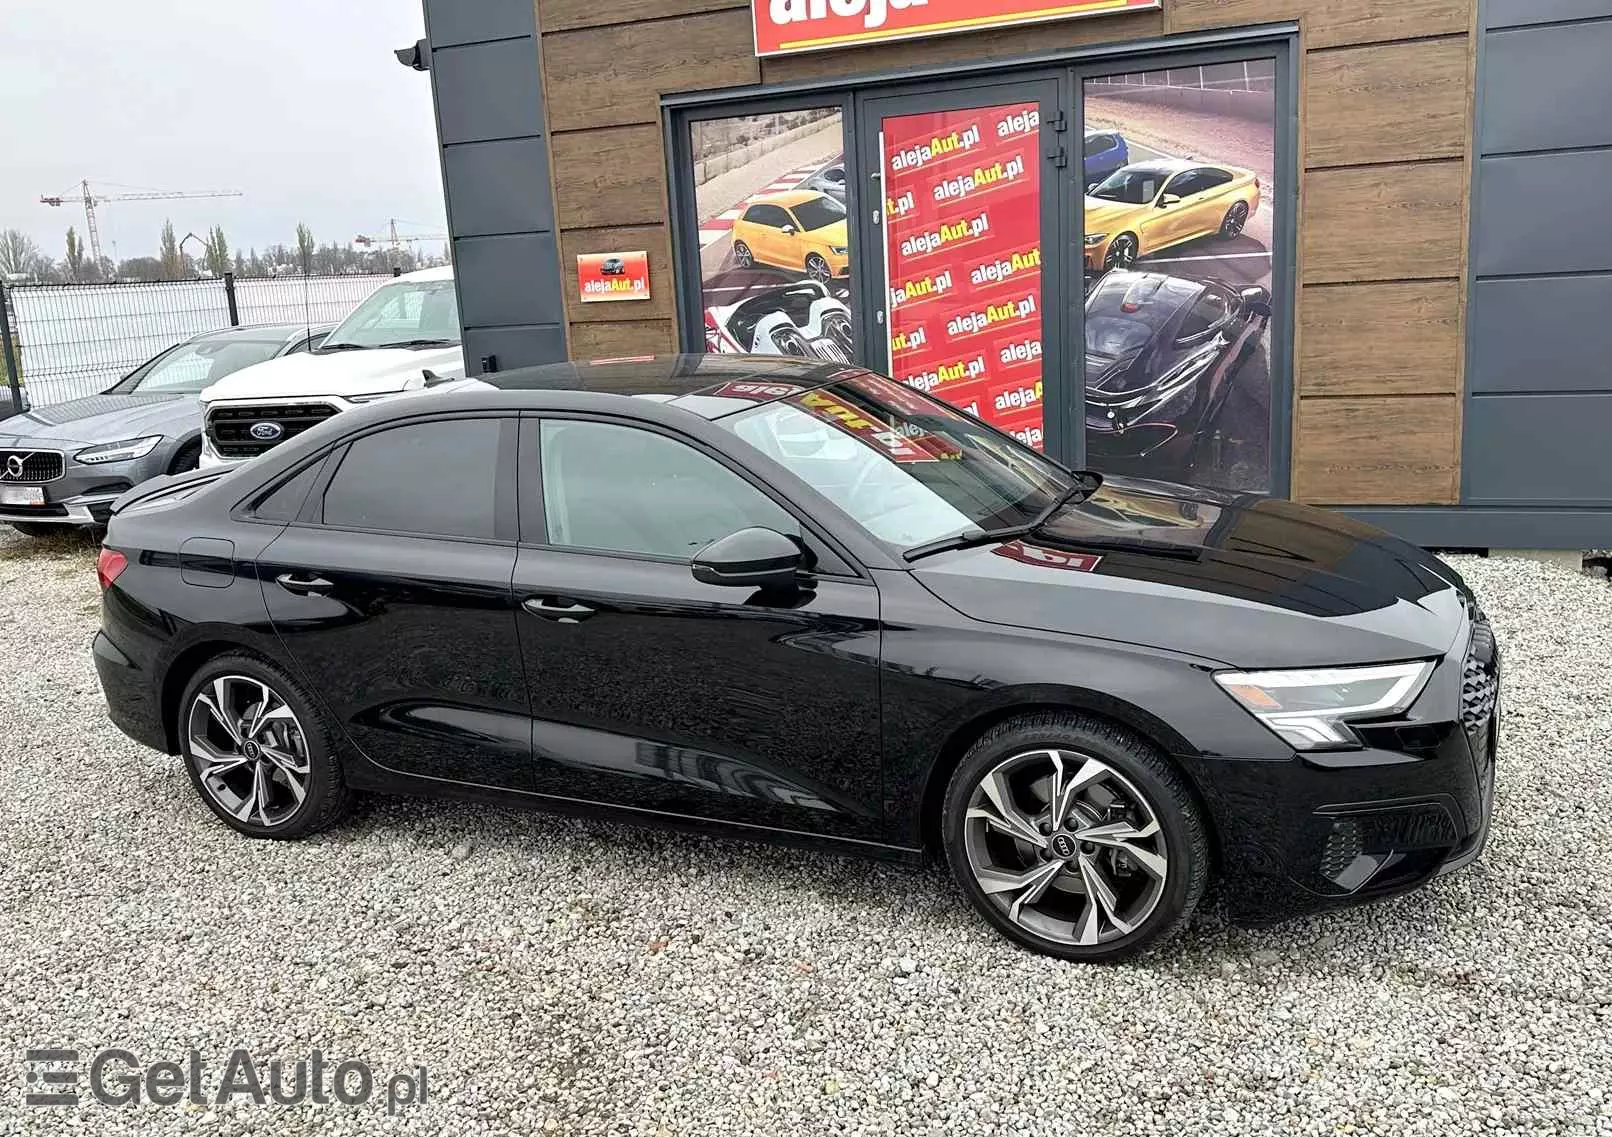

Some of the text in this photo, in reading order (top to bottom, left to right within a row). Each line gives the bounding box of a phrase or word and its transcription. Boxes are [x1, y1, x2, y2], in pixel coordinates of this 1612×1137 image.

[997, 110, 1039, 137] aleja
[891, 125, 980, 171] alejaAut.pl
[933, 155, 1024, 201] alejaAut.pl
[901, 213, 989, 256] alejaAut.pl
[584, 276, 645, 293] alejaAut.pl
[947, 295, 1036, 336] alejaAut.pl
[1000, 339, 1042, 363] aleja
[902, 356, 985, 393] lejaAut.pl
